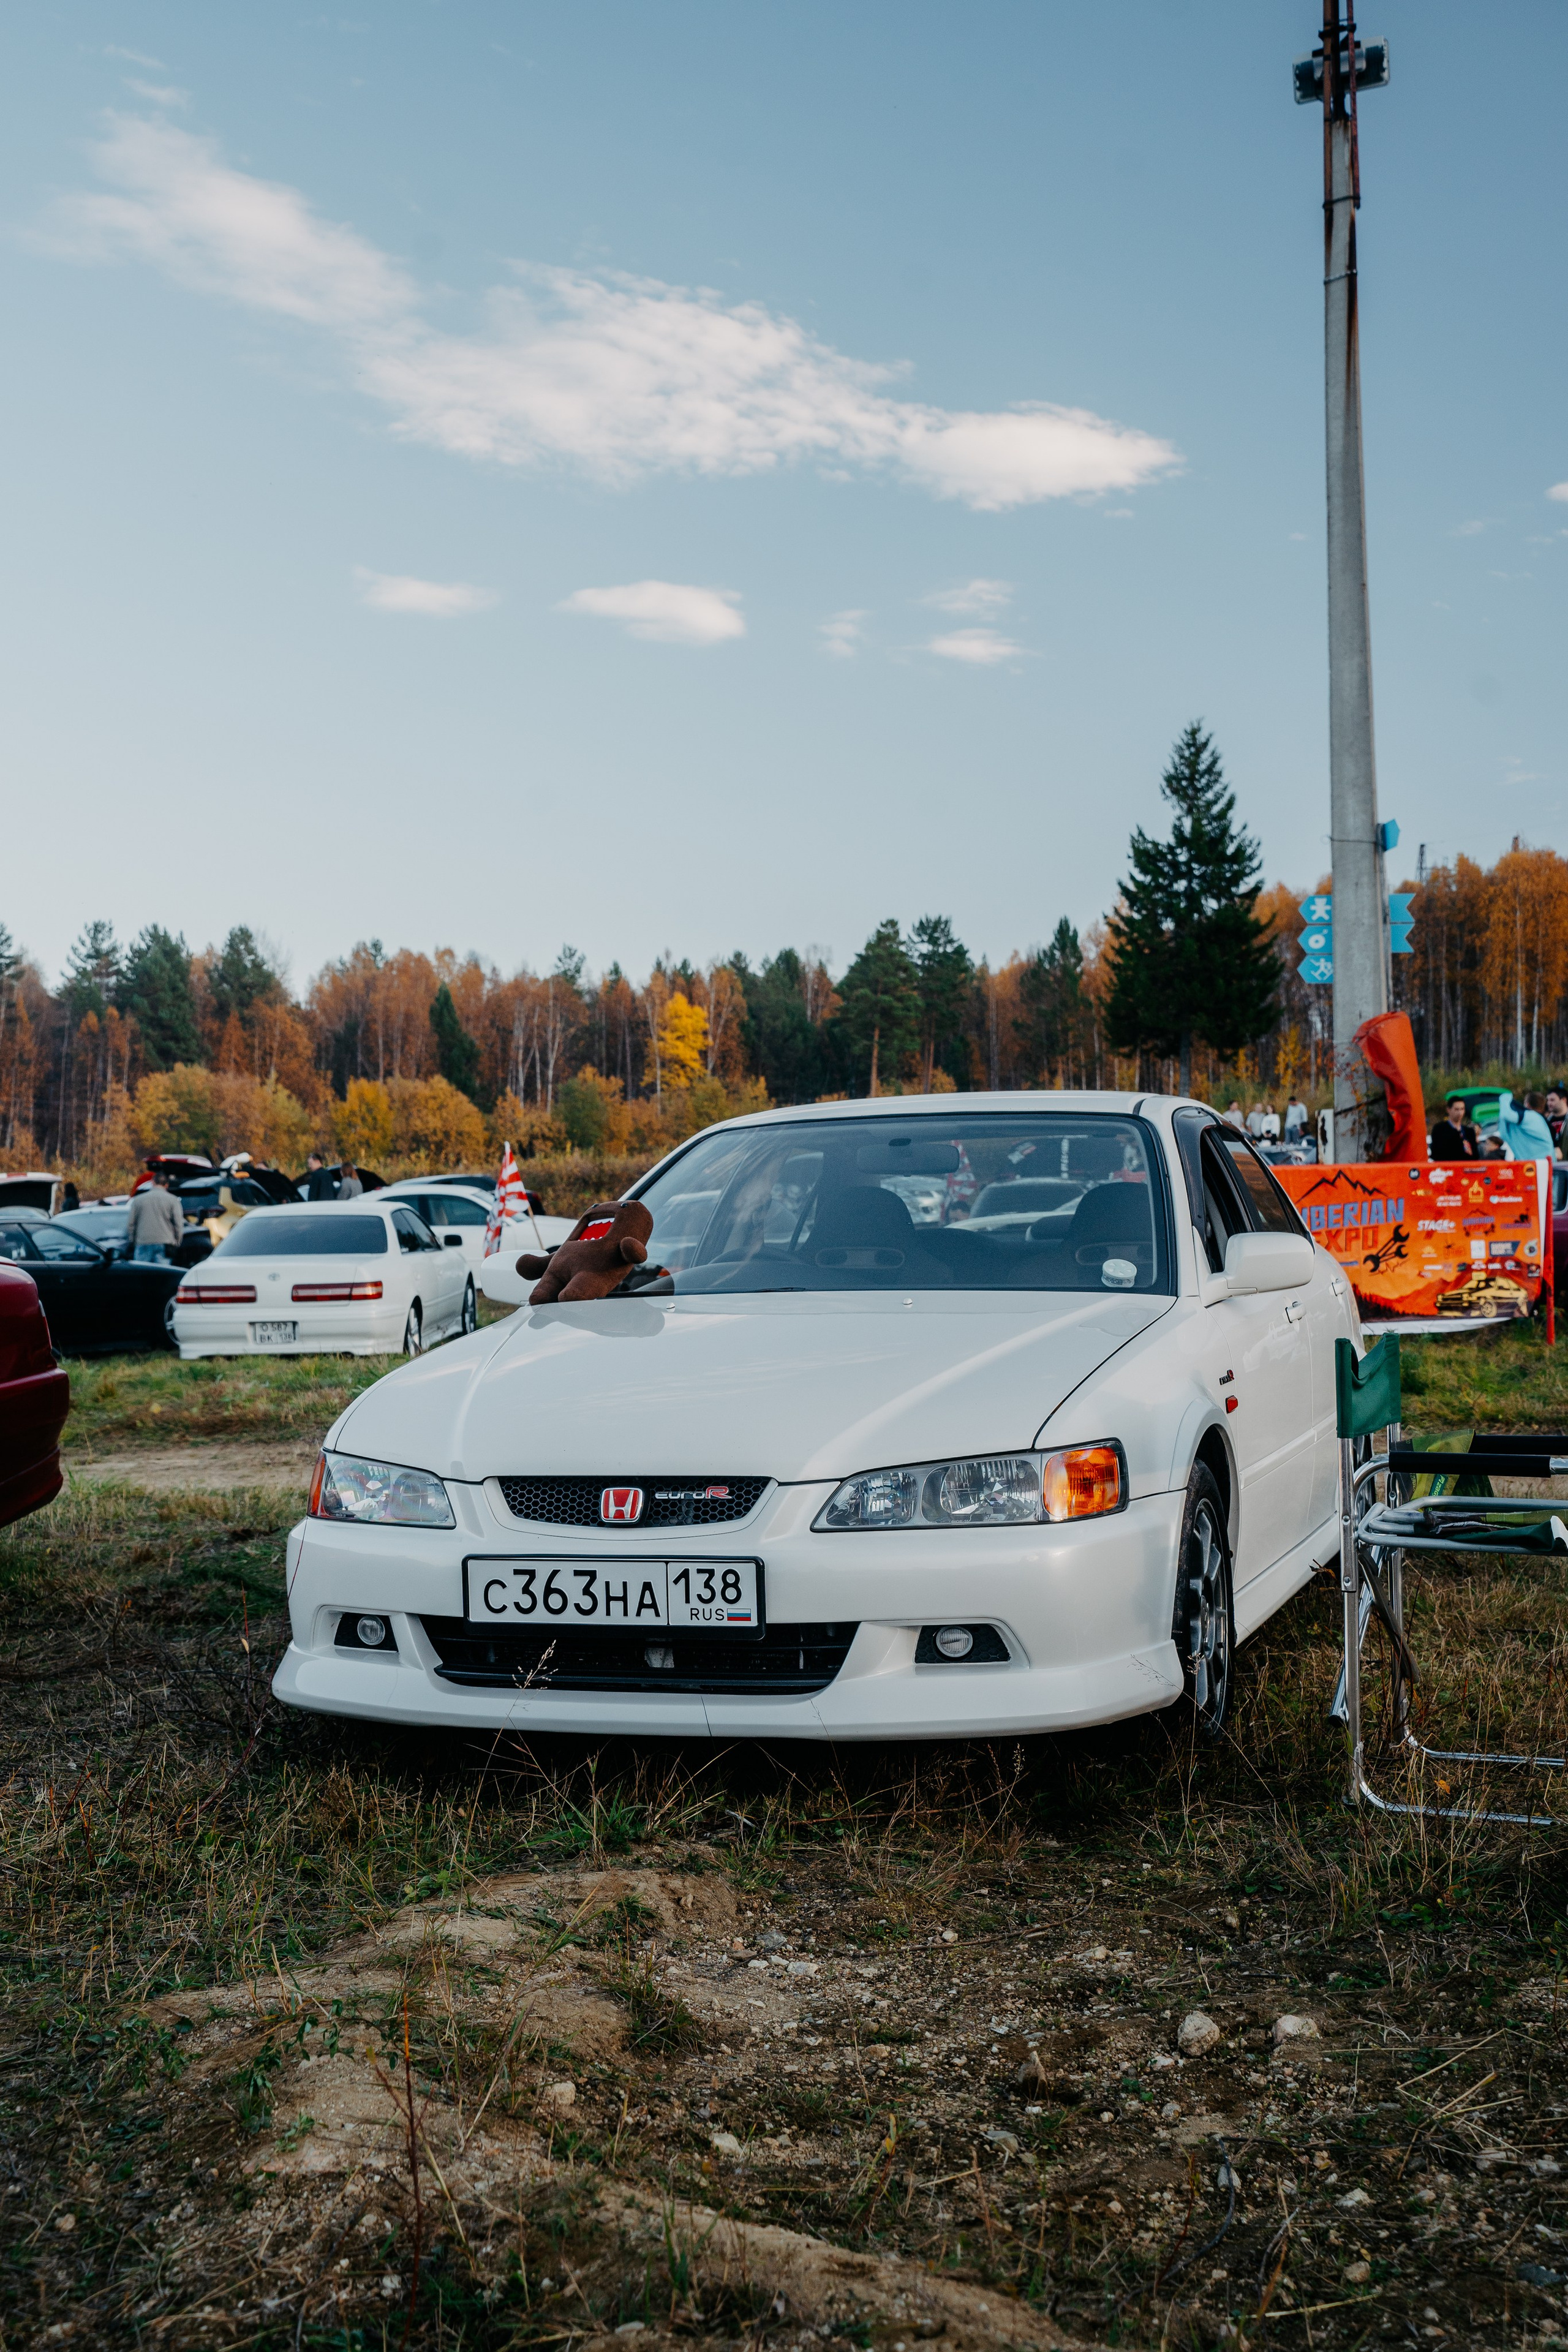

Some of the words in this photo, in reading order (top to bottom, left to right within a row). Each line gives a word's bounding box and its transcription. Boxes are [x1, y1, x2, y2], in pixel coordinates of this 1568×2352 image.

[1297, 1197, 1404, 1231] IBERIAN
[1311, 1226, 1378, 1253] XPO
[673, 1568, 742, 1604] 138
[690, 1608, 725, 1621] RUS
